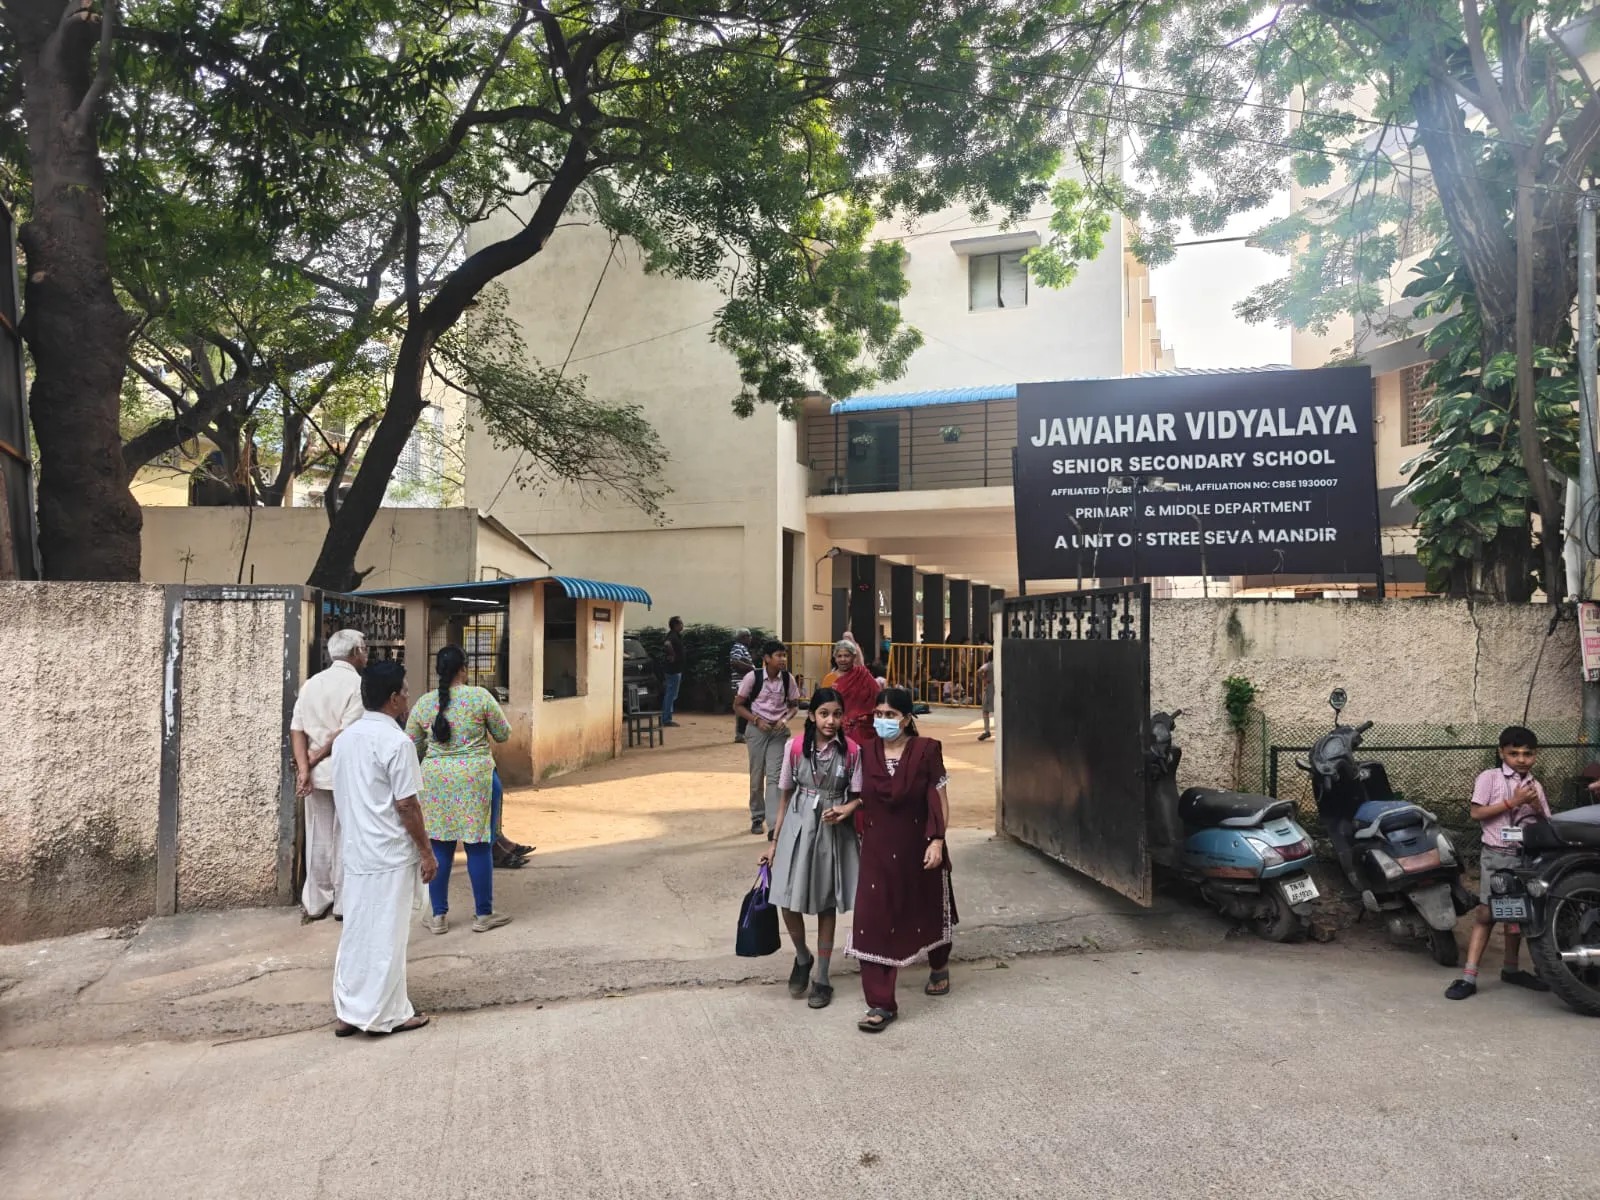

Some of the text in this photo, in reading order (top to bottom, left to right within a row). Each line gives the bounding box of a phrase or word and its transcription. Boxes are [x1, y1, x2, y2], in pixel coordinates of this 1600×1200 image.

[1031, 405, 1357, 447] JAWAHAR VIDYALAYA
[1052, 449, 1336, 475] SENIOR SECONDARY SCHOOL
[1051, 487, 1100, 496] AFFILIATED
[1196, 481, 1251, 491] AFFILIATION
[1253, 481, 1271, 489] NO:
[1272, 479, 1297, 488] CBSE
[1298, 478, 1338, 487] 1930007
[1144, 505, 1155, 517] &
[1159, 503, 1211, 516] MIDDLE
[1214, 500, 1312, 515] DEPARTMENT
[1054, 534, 1068, 549] A
[1146, 531, 1200, 546] STREE
[1204, 529, 1254, 545] SEVA
[1258, 527, 1337, 543] MANDIR
